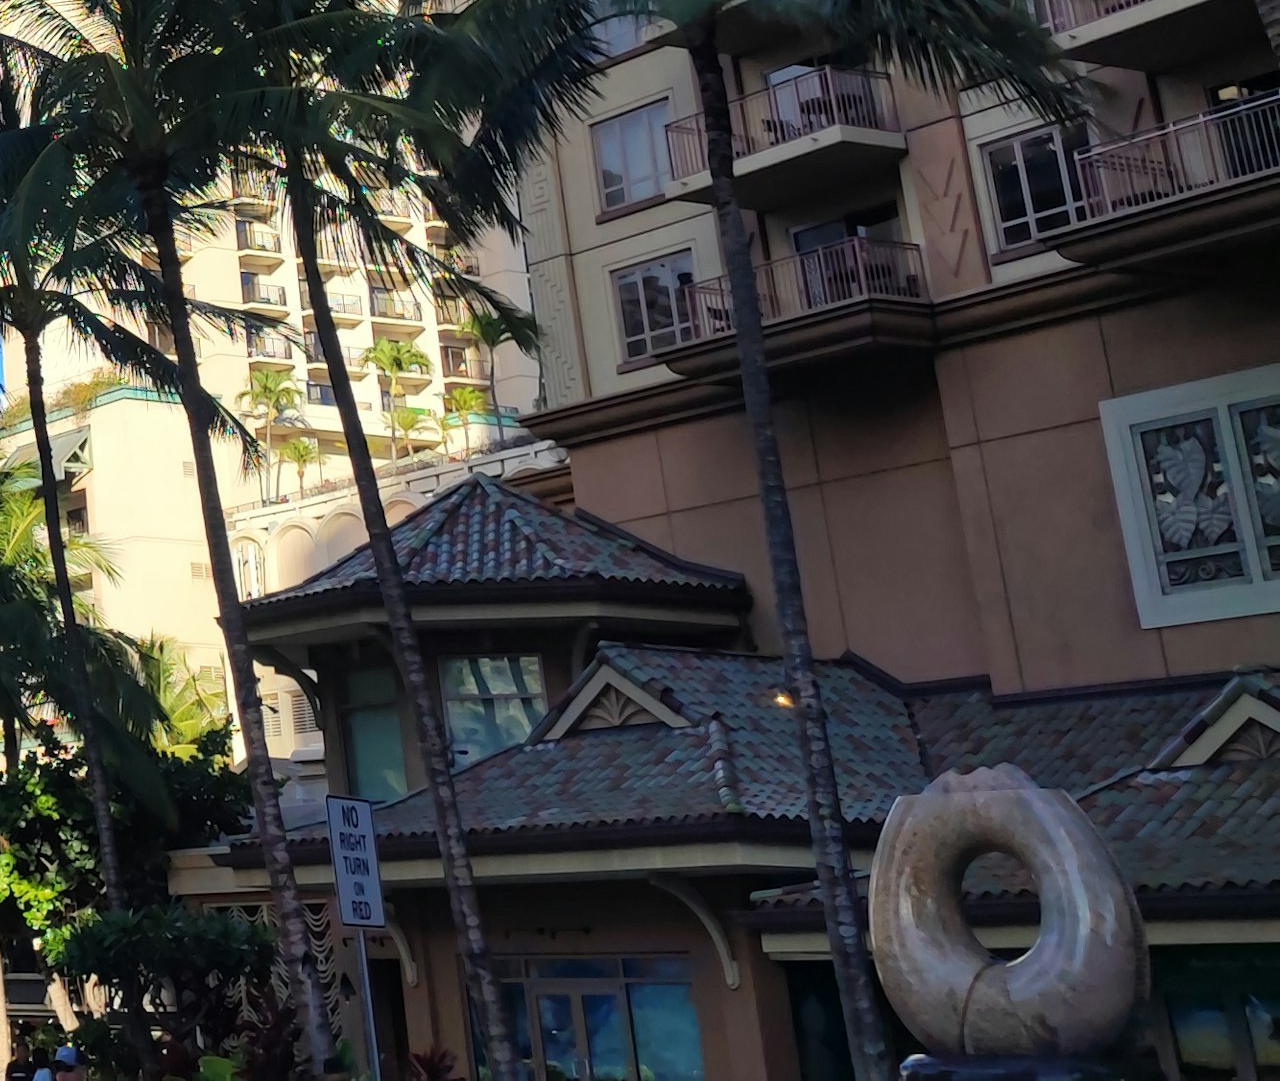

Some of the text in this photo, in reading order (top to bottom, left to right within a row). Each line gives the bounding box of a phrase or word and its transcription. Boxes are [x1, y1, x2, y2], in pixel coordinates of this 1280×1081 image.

[341, 805, 359, 829] NO
[339, 832, 367, 853] RIGHT
[342, 856, 370, 876] TURN
[351, 900, 372, 920] RED
